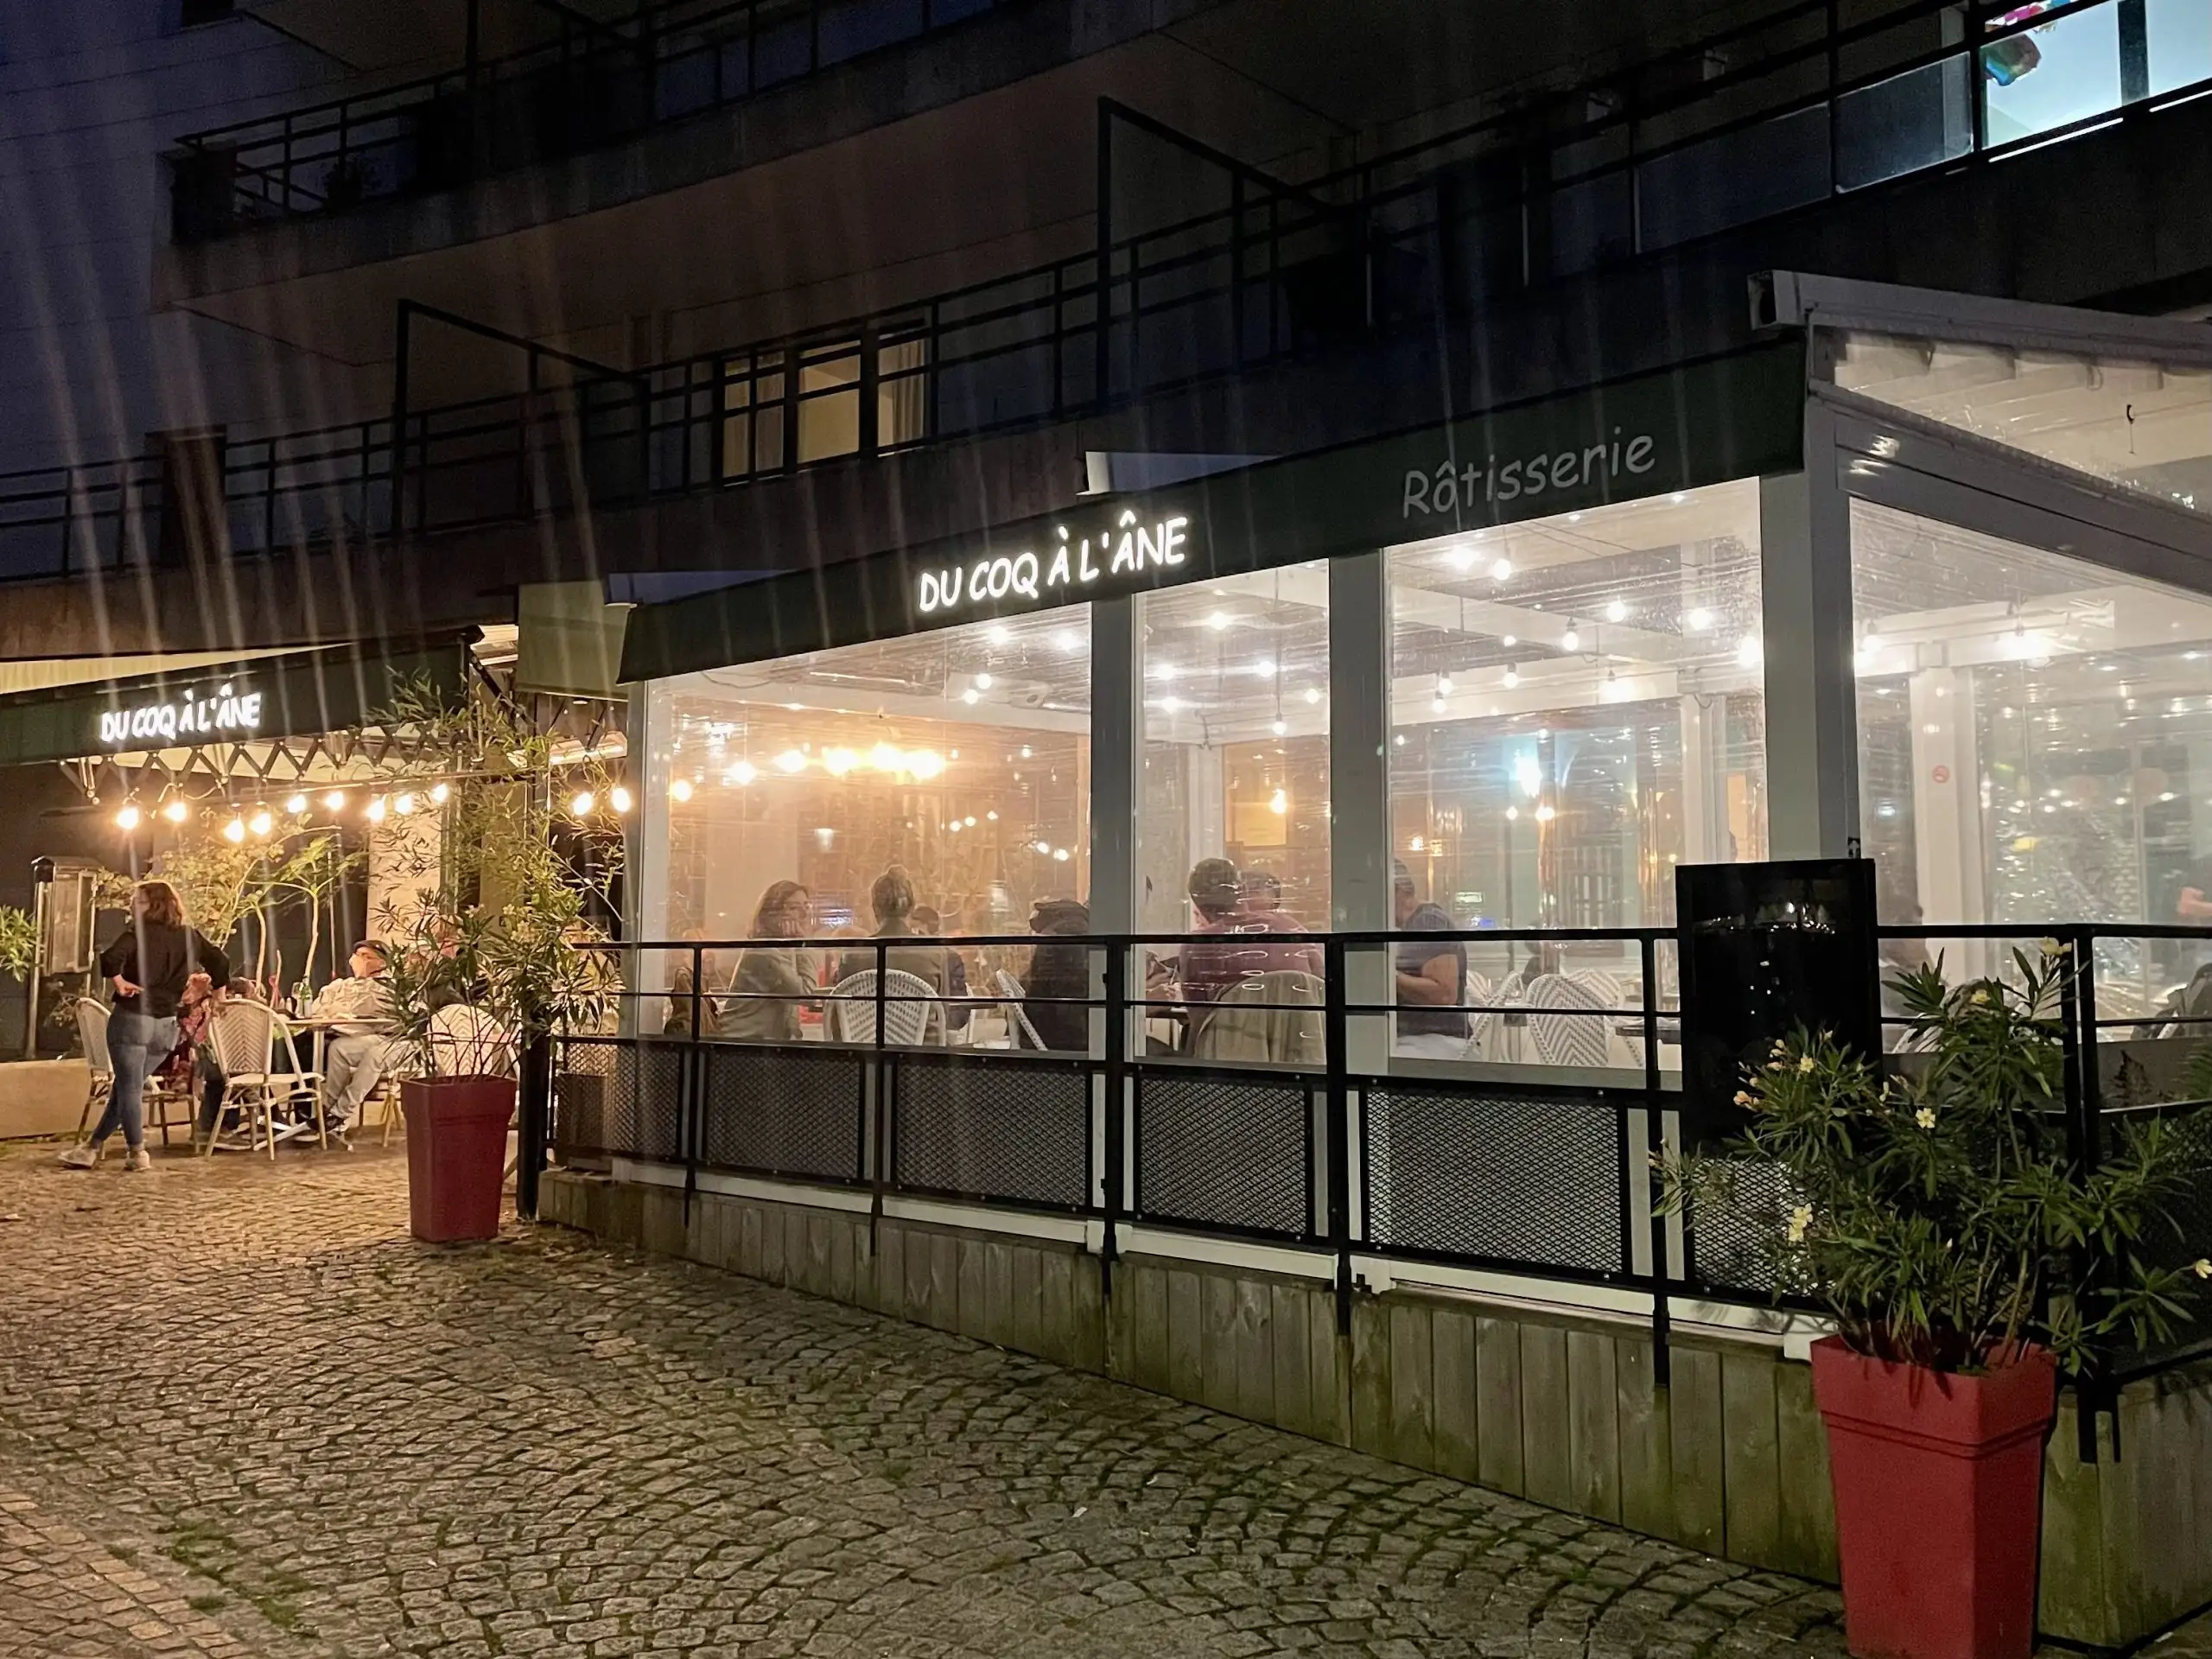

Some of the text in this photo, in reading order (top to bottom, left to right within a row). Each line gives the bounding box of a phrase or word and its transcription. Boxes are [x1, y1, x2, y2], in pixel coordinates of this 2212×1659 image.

[1403, 426, 1655, 518] Rôtisserie
[919, 567, 962, 612] DU
[969, 552, 1039, 599] COQ
[1047, 525, 1071, 586] À
[101, 711, 130, 742] DU
[132, 704, 176, 741] COQ
[179, 688, 194, 732] À
